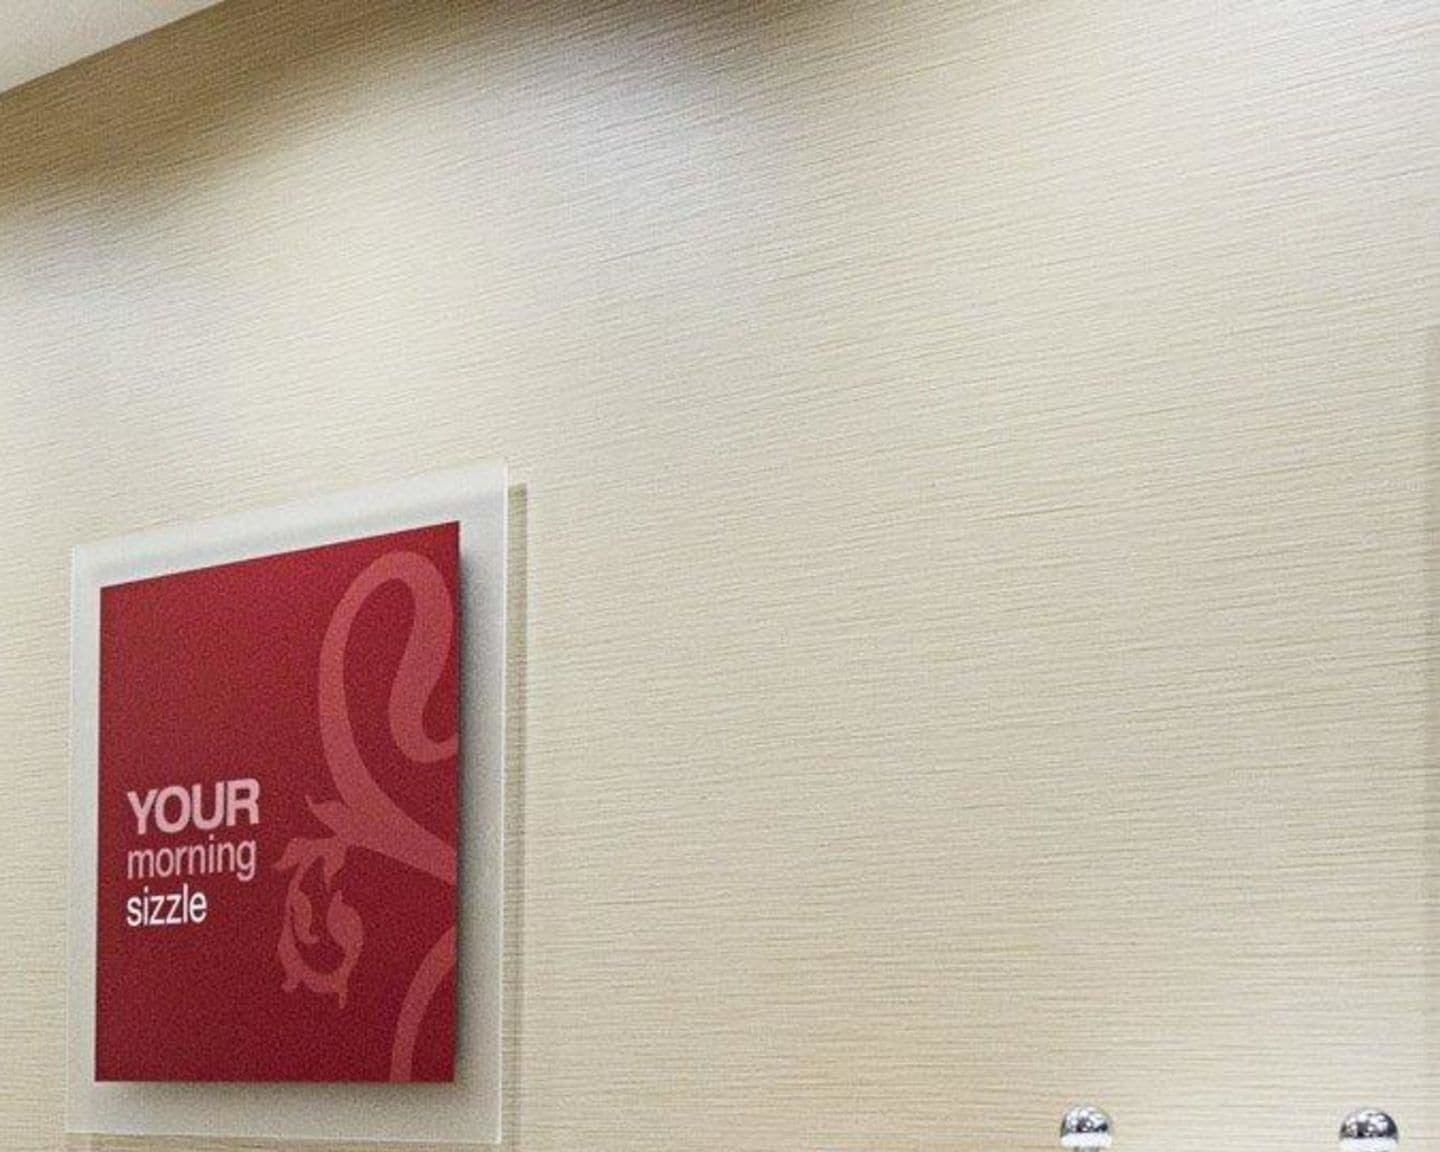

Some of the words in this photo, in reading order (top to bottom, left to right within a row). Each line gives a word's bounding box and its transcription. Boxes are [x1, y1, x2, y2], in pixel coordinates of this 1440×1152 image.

[127, 778, 260, 835] YOUR
[127, 834, 257, 882] morning
[126, 883, 208, 927] sizzle
